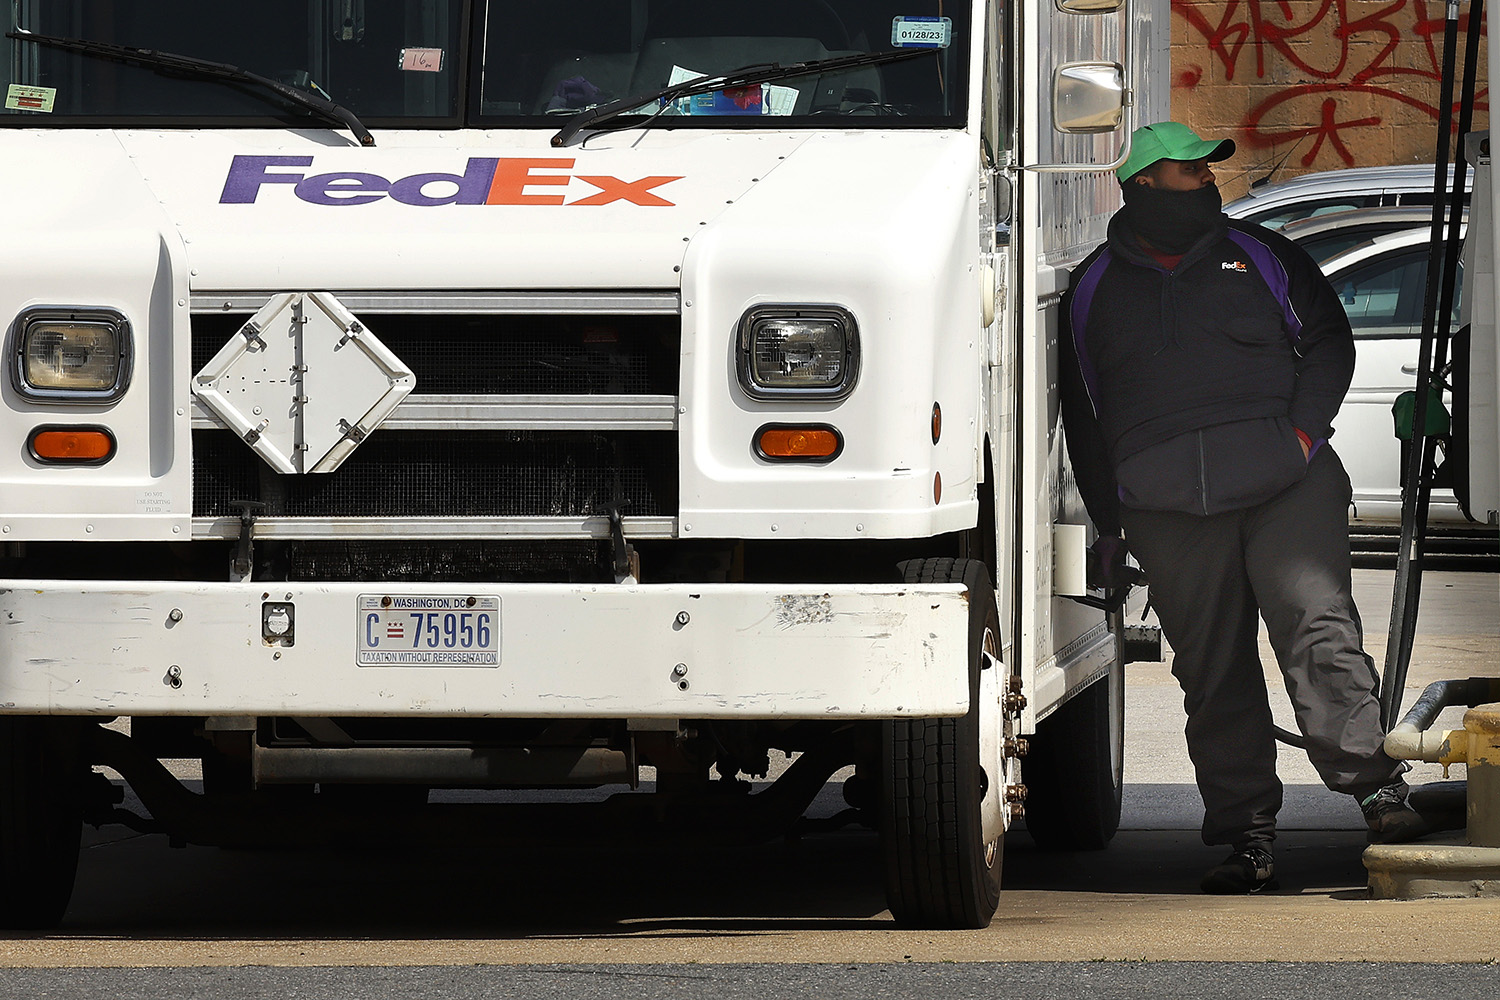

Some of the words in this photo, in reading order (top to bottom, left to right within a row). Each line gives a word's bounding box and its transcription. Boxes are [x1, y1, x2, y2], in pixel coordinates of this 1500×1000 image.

[901, 30, 940, 40] 01/28/23
[219, 155, 687, 207] FedEx
[1221, 261, 1247, 270] FedEx
[393, 598, 452, 609] WASHINGTON,
[453, 598, 466, 608] DC
[366, 613, 380, 648] C
[410, 613, 490, 648] 75956
[362, 652, 397, 663] TAXATION
[399, 652, 432, 662] WITHOUT
[433, 652, 497, 664] REPRESENTATION
